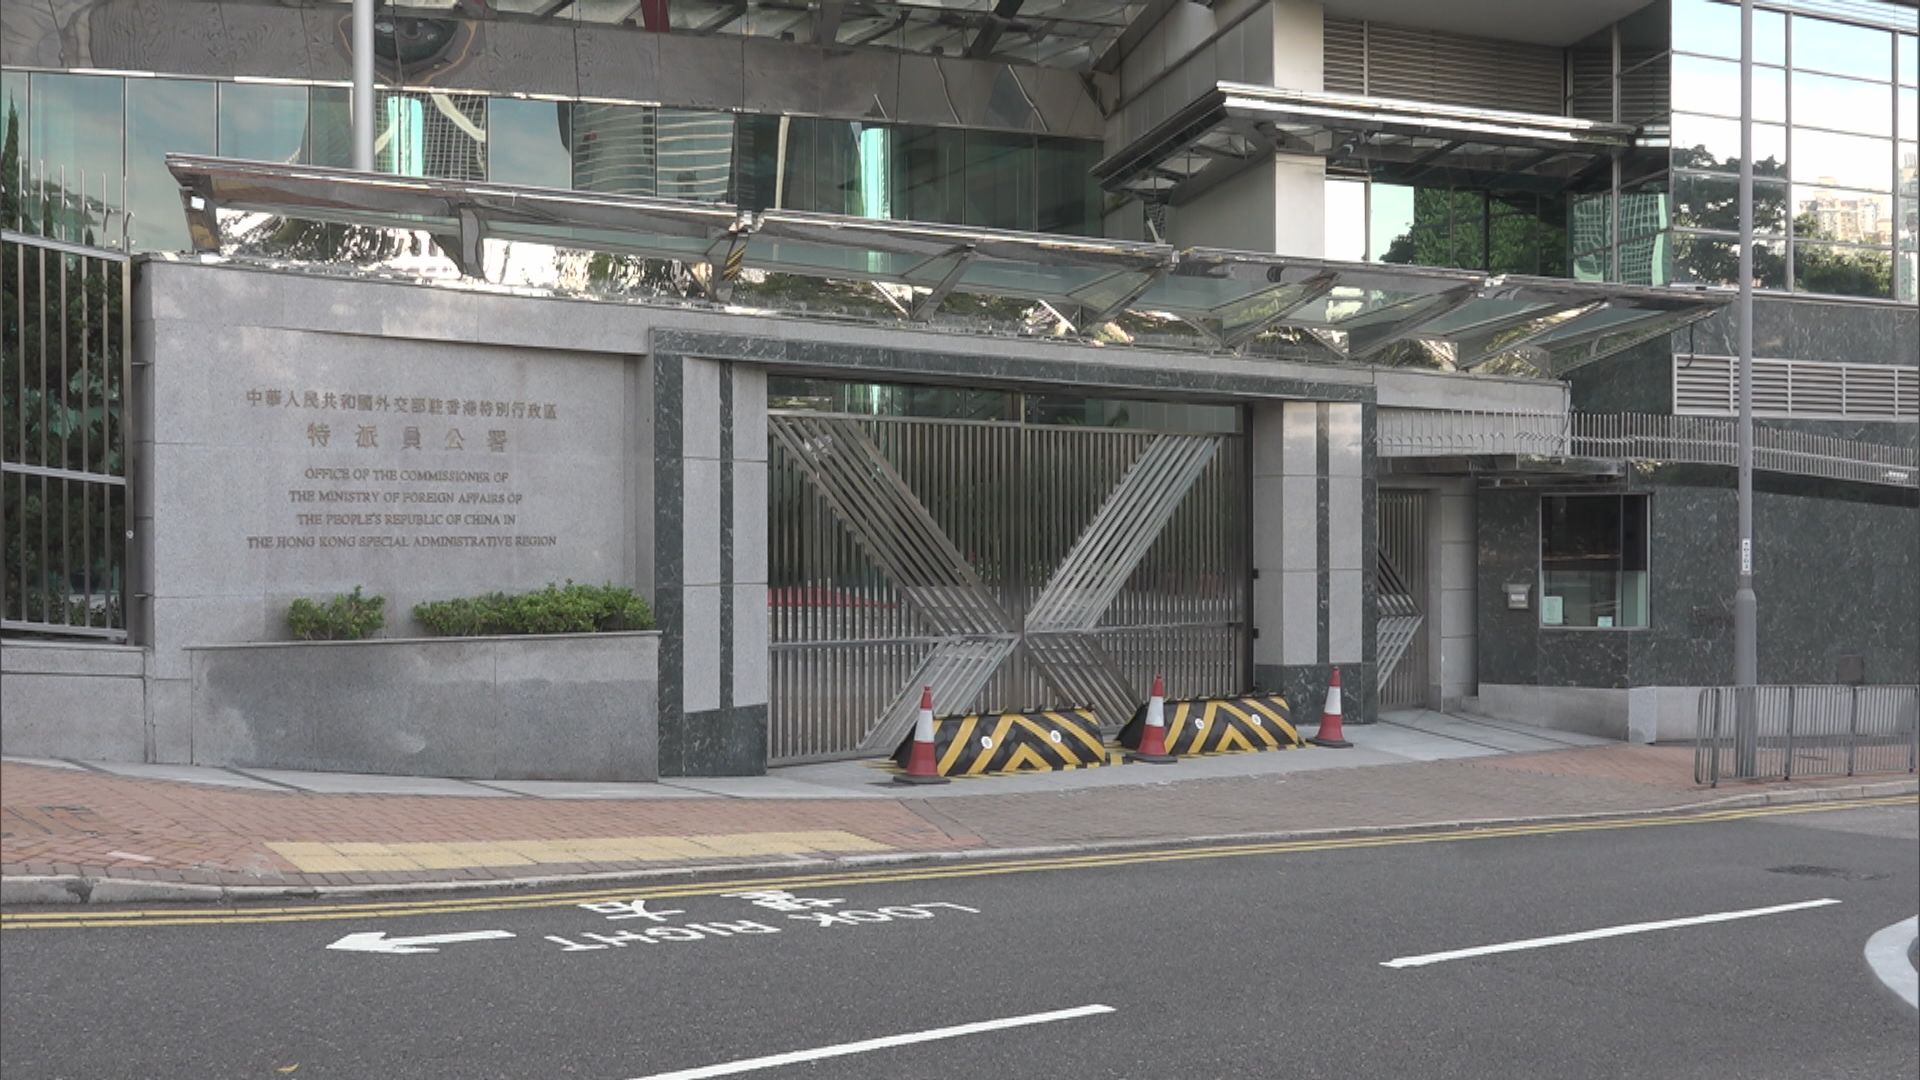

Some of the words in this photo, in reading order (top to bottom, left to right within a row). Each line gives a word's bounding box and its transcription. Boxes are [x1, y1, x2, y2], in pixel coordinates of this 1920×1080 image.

[306, 422, 508, 453] 特派員公署
[304, 468, 349, 481] OFFICE
[353, 468, 370, 481] OF
[373, 469, 398, 482] THE
[400, 470, 490, 483] COMMISSIONER
[493, 472, 509, 484] OF
[288, 490, 315, 503] THE
[318, 490, 380, 504] MINISTRY
[383, 491, 400, 504] OF
[403, 492, 455, 504] FOREIGN
[458, 492, 504, 505] AFFAIRS
[507, 493, 523, 505] OF
[296, 514, 322, 526] THE
[326, 512, 382, 526] PEOPLE'S
[384, 513, 443, 526] REPUBLIC
[446, 514, 463, 526] OF
[464, 514, 500, 526] CHINA
[503, 514, 516, 526] IN
[246, 536, 273, 549] THE
[276, 536, 315, 548] HONG
[319, 536, 356, 548] KONG
[359, 535, 408, 548] SPECIAL
[413, 535, 512, 548] ADMINISTRATIVE
[514, 535, 557, 548] REGION
[787, 901, 981, 927] LOOK
[544, 919, 782, 952] RIGHT
